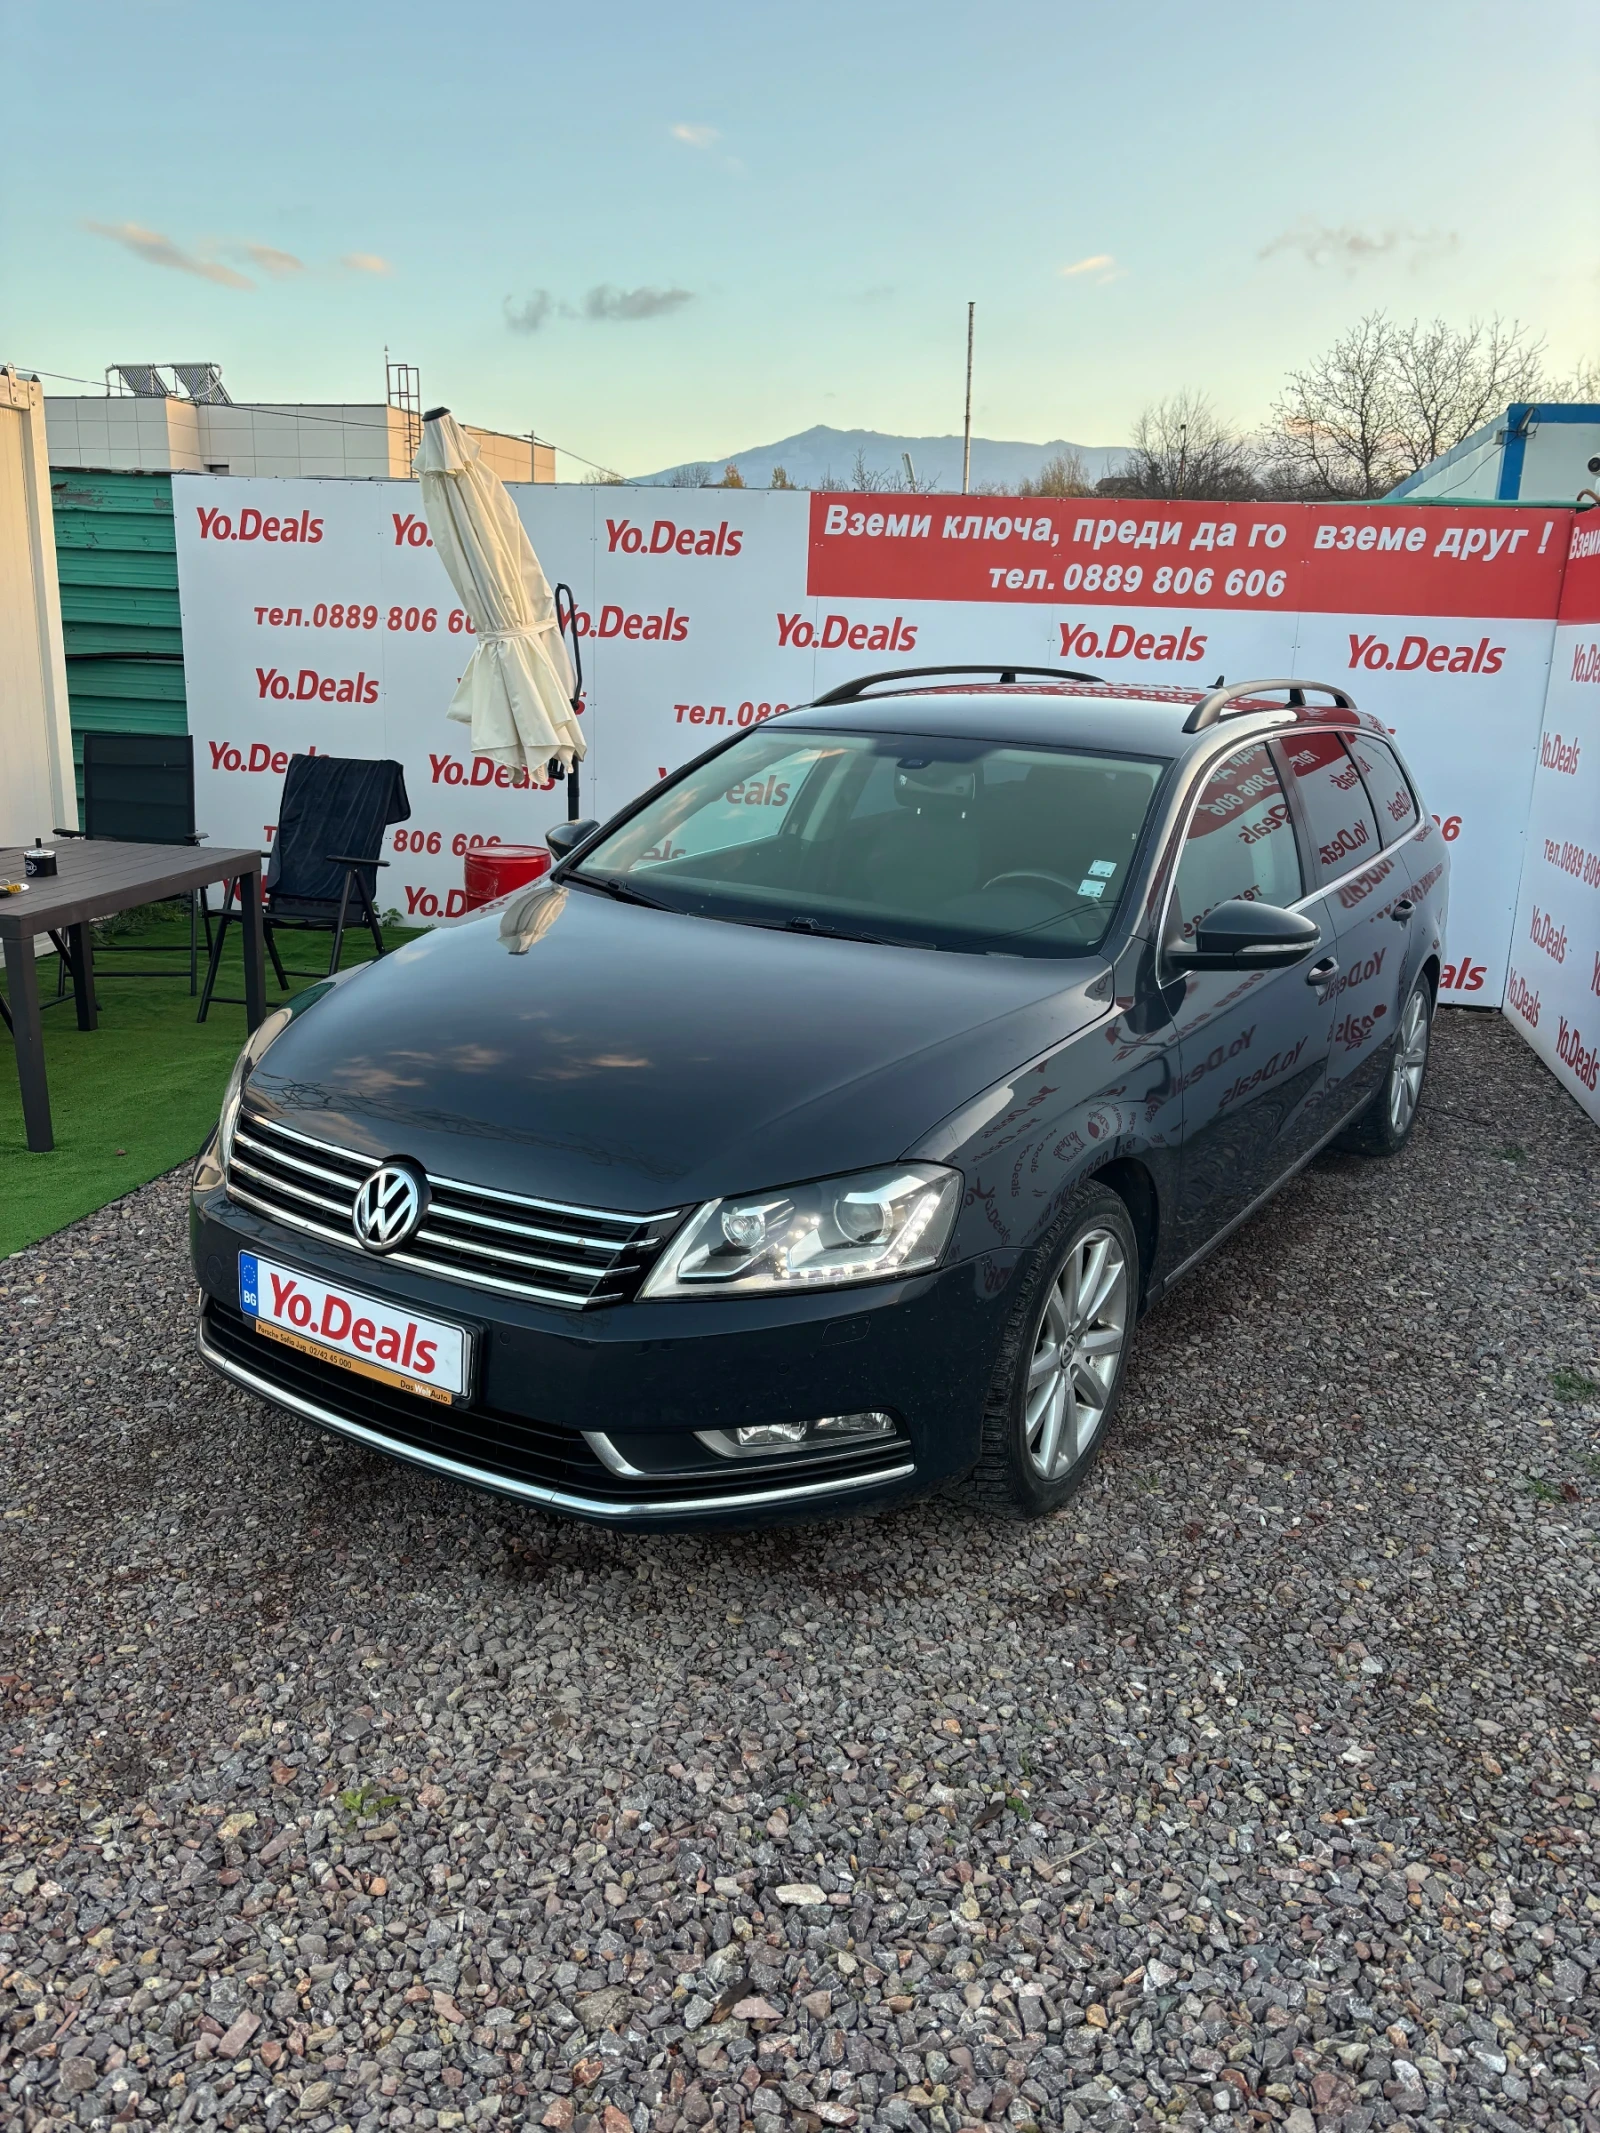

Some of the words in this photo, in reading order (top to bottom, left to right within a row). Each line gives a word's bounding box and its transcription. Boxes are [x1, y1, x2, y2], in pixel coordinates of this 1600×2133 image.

[196, 507, 324, 544] Yo.Deals
[605, 519, 744, 556] Yo.Deals
[824, 505, 932, 538] Вземи
[942, 514, 1060, 547] ключа,
[1072, 518, 1183, 550] преди
[1189, 522, 1237, 551] да
[1248, 523, 1287, 548] го
[1313, 524, 1427, 550] вземе
[1433, 528, 1529, 561] друг
[1537, 522, 1554, 554] !
[989, 567, 1055, 590] тел.
[1063, 563, 1143, 593] 0889
[1152, 566, 1214, 595] 806
[1224, 568, 1287, 598] 606
[254, 603, 378, 630] тел.0889
[387, 606, 438, 633] 806
[558, 603, 690, 642] Yo.Deals
[776, 613, 919, 652] Yo.Deals
[1059, 622, 1208, 662] Yo.Deals
[1348, 634, 1507, 674] Yo.Deals
[255, 667, 380, 705] Yo.Deals
[673, 701, 790, 727] тел.08
[208, 741, 330, 774] Yo.De
[1540, 732, 1580, 775] Yo.Deals
[393, 829, 442, 855] 806
[1529, 904, 1568, 964] Yo.Deals
[1507, 966, 1541, 1028] Yo.Deals
[1556, 1015, 1600, 1091] Yo.Deals
[243, 1290, 257, 1307] BG
[269, 1272, 438, 1374] Yo.Deals
[329, 1354, 338, 1364] 45
[340, 1359, 352, 1369] 000
[400, 1379, 414, 1391] Das
